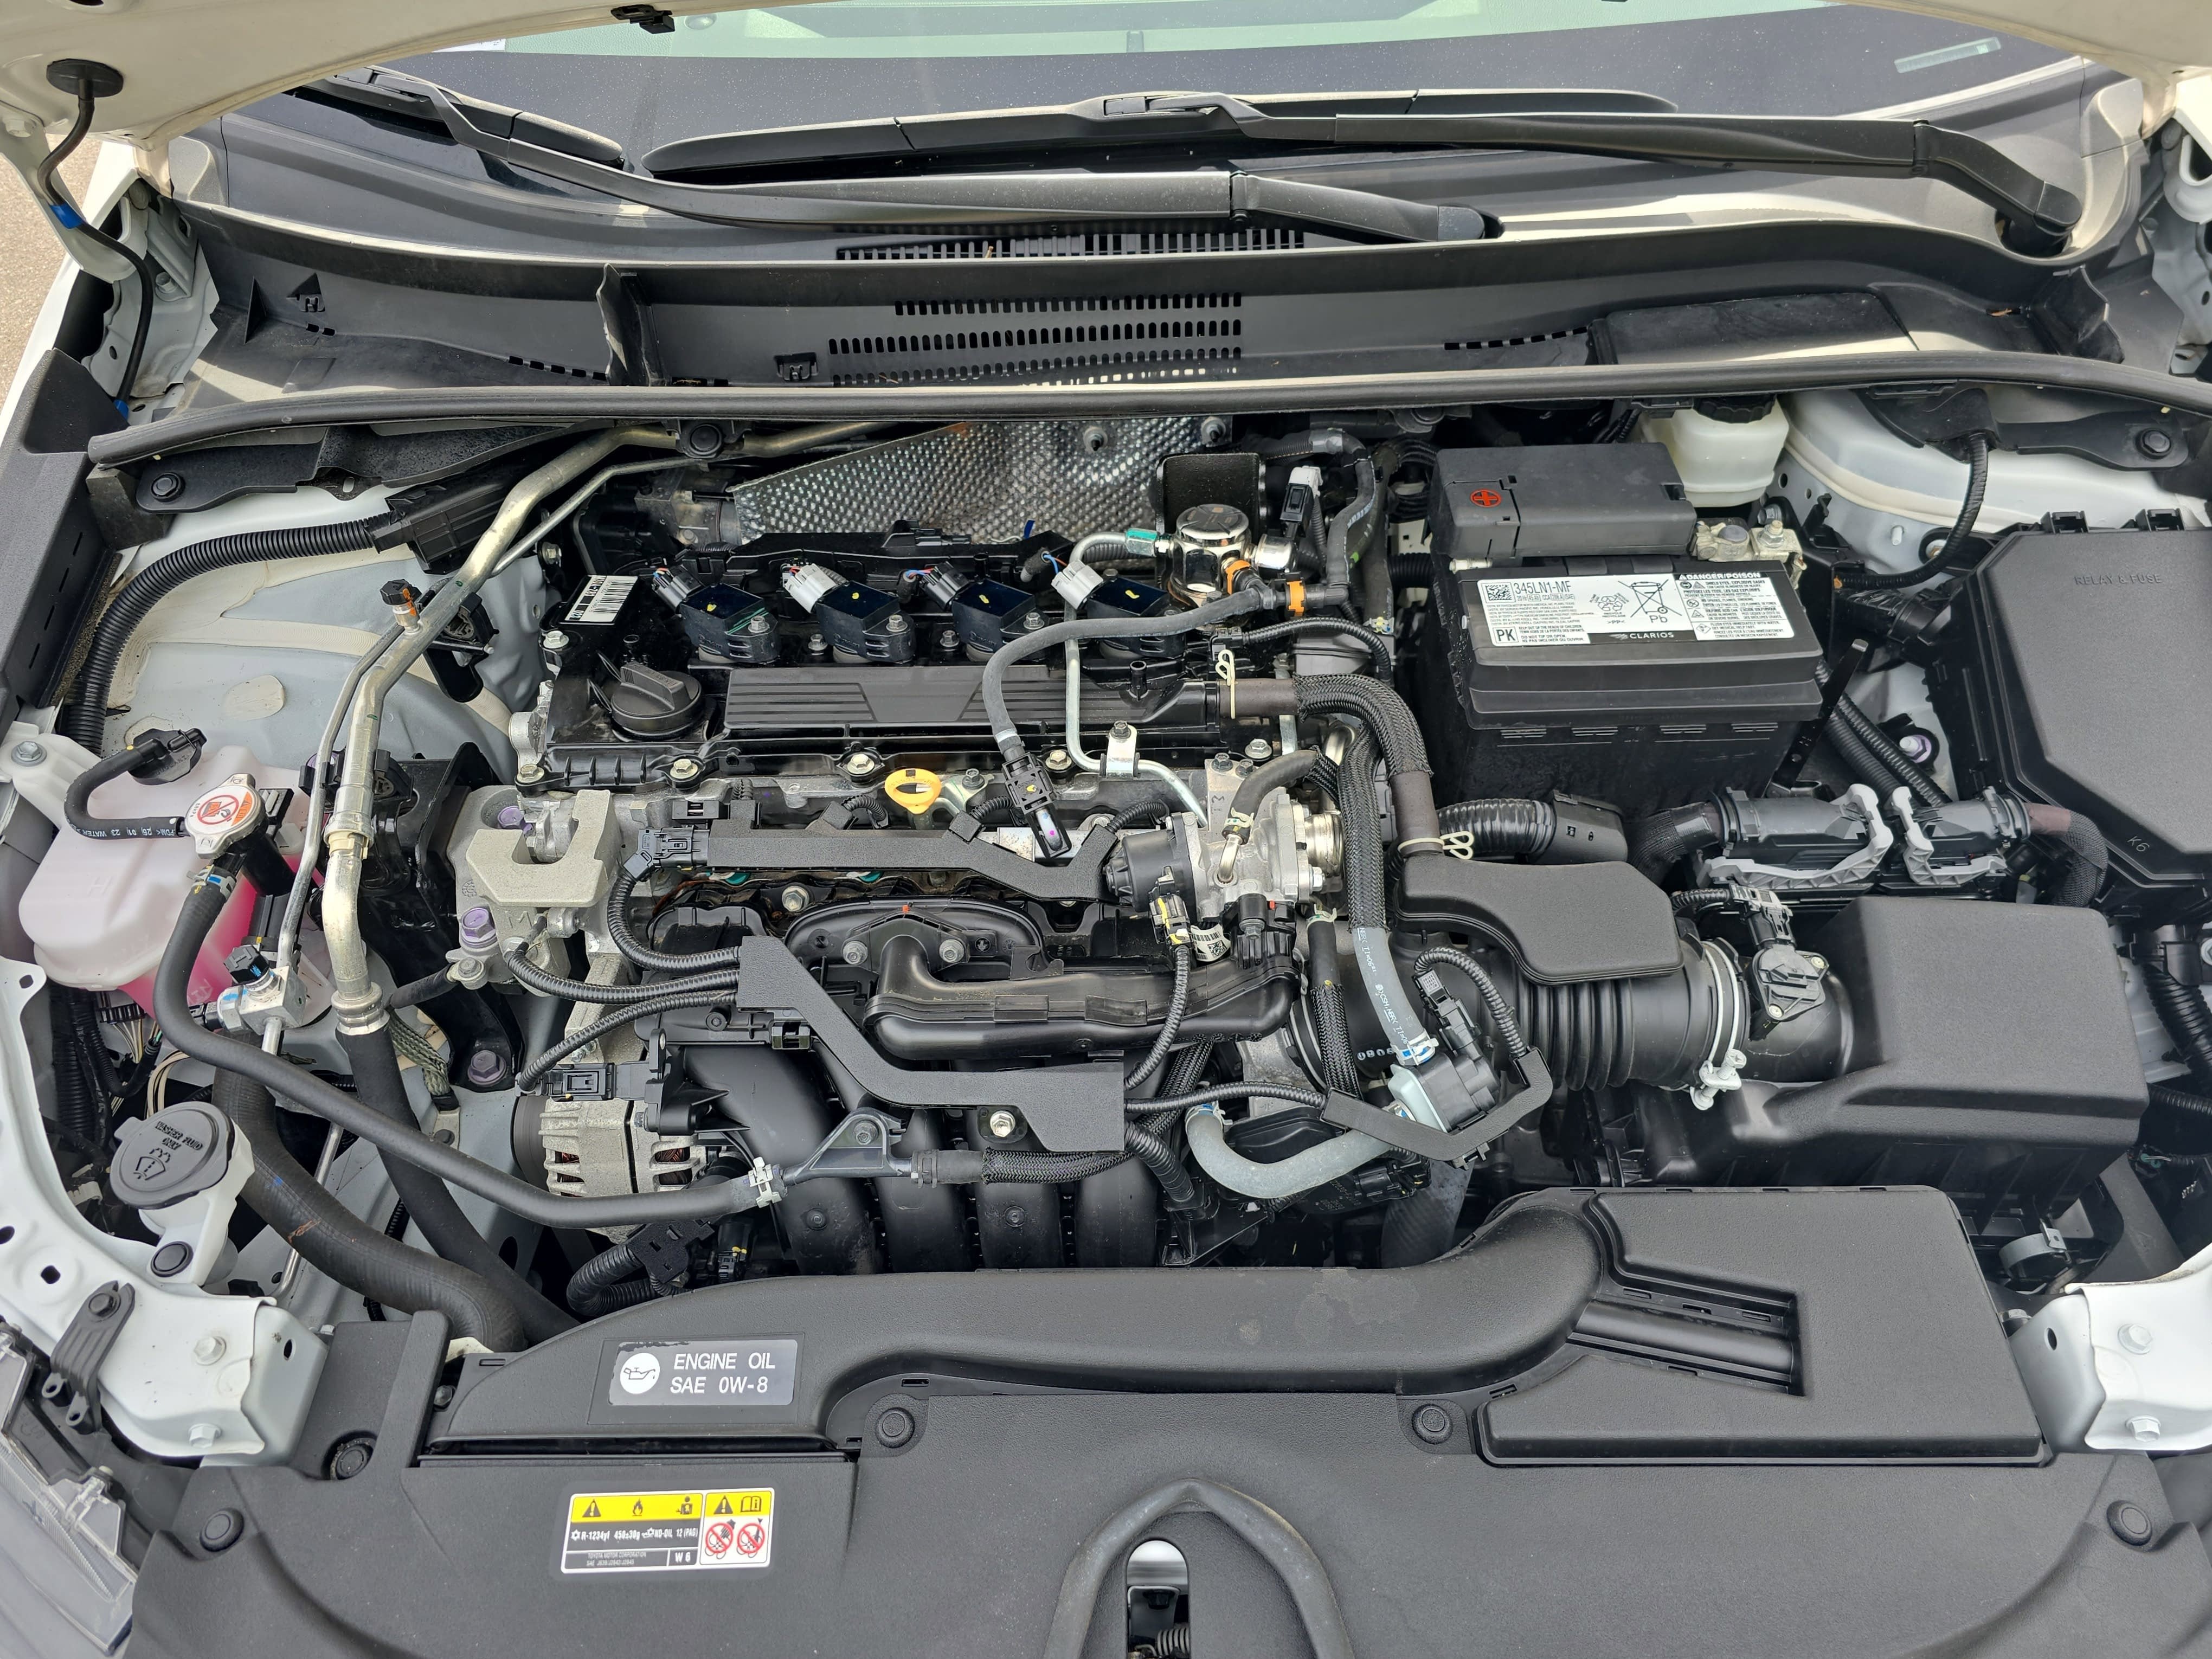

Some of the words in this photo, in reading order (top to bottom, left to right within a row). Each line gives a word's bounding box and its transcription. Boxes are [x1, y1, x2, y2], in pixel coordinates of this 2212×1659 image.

[2074, 576, 2112, 585] RELAY
[2130, 574, 2162, 583] FUSE
[1514, 581, 1571, 594] 345LN1-MF
[1496, 629, 1515, 641] PK
[81, 829, 107, 837] WATER
[2127, 836, 2150, 851] K6
[155, 1121, 183, 1140] WASHER
[182, 1137, 203, 1150] FLUID
[162, 1137, 182, 1150] ONLY
[674, 1353, 737, 1369] ENGINE
[748, 1352, 775, 1369] OIL
[670, 1377, 707, 1393] SAE
[719, 1376, 768, 1393] 0W-8
[581, 1530, 610, 1541] R-1234yf
[614, 1529, 640, 1541] 450±30g
[654, 1528, 672, 1538] ND-OIL
[677, 1528, 682, 1536] 12
[684, 1528, 698, 1538] (PAG)
[675, 1552, 683, 1562] W
